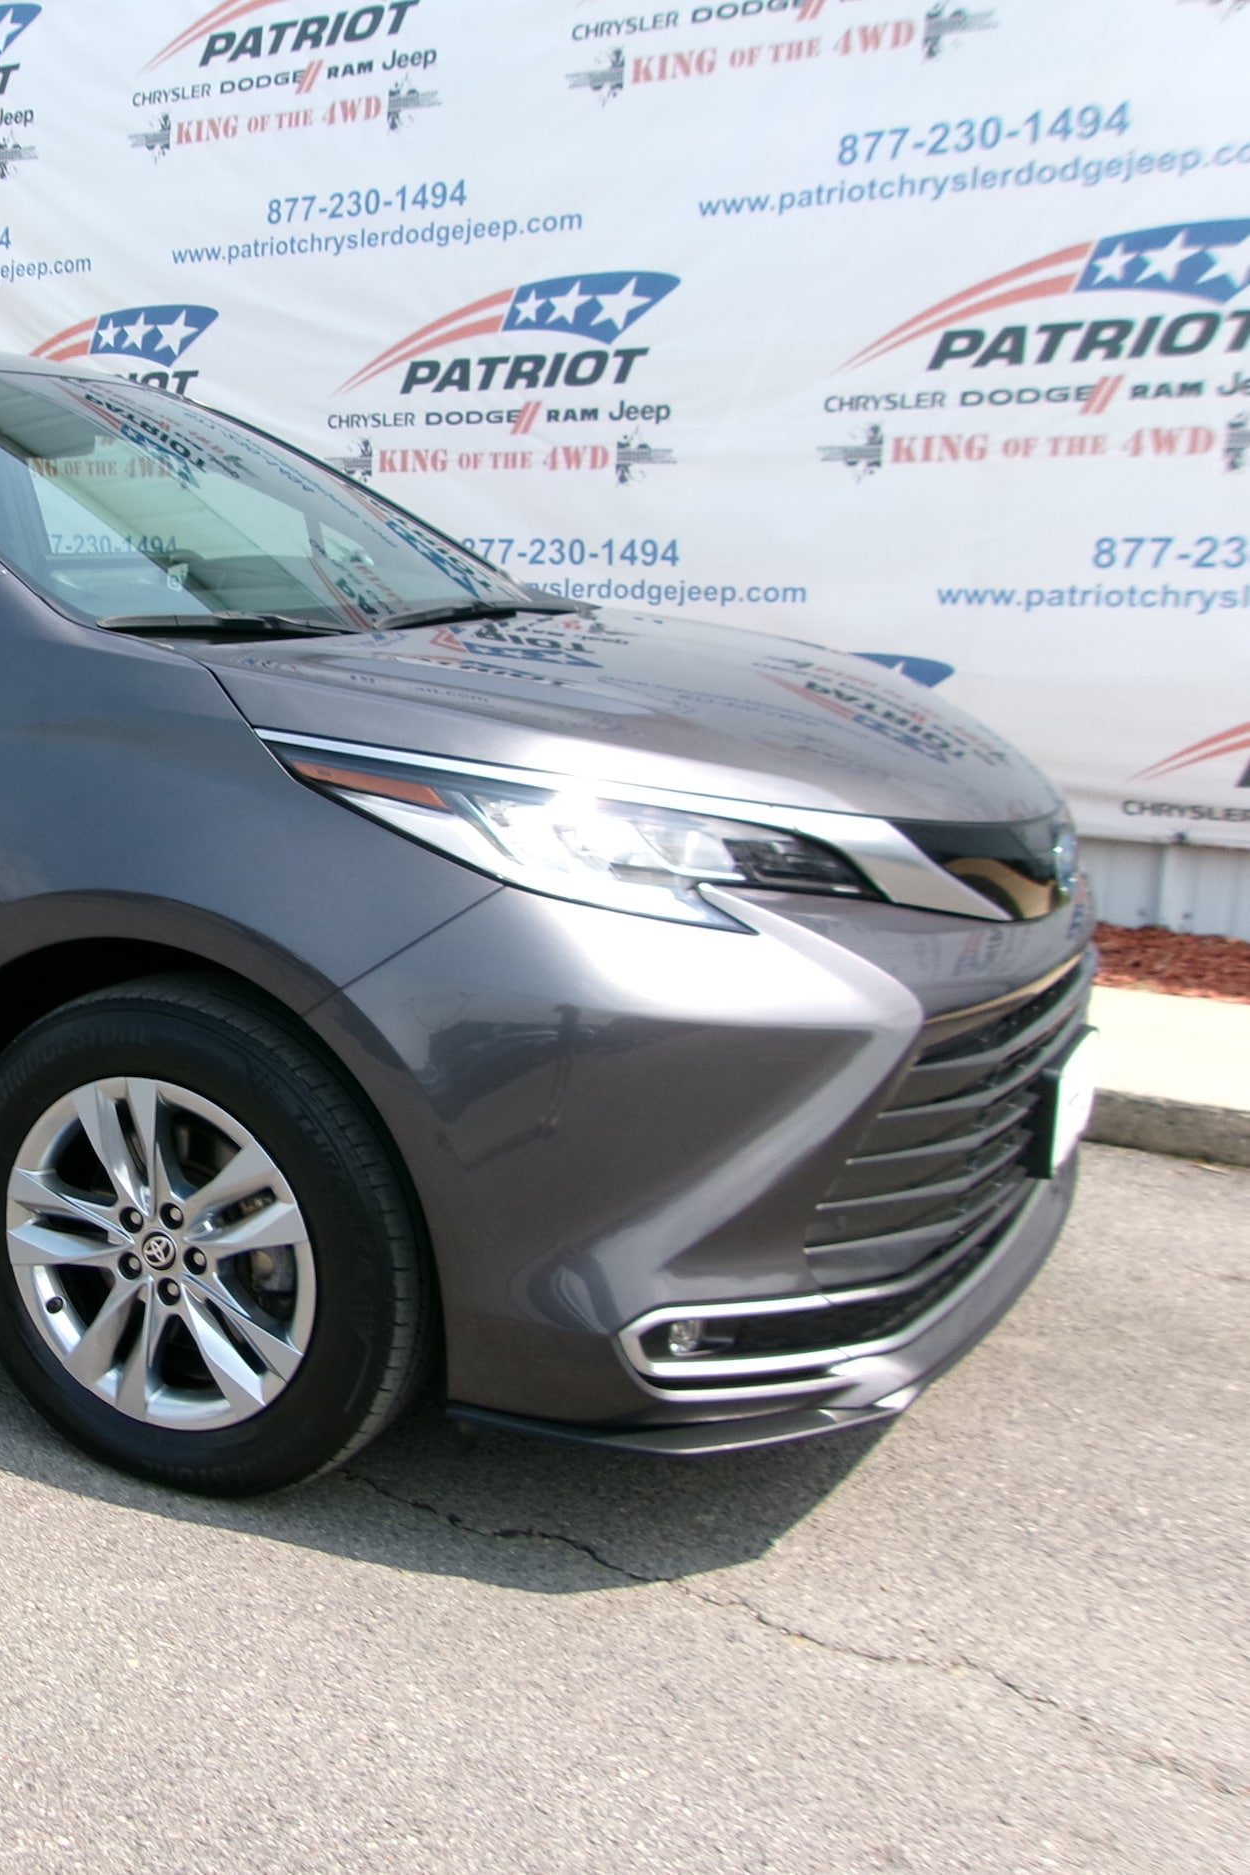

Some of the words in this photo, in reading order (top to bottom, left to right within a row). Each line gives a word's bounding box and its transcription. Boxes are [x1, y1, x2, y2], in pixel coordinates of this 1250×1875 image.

[199, 0, 420, 67] PATRIOT
[570, 11, 680, 42] CHRYSLER
[630, 46, 717, 86] KING
[730, 45, 762, 69] OF
[769, 37, 822, 64] THE
[833, 20, 916, 58] 4WD
[132, 83, 212, 107] CHRYSLER
[220, 69, 304, 94] DODGE
[327, 60, 374, 80] RAM
[382, 47, 437, 72] Jeep
[175, 114, 239, 145] KING
[247, 113, 271, 132] OF
[277, 108, 314, 130] THE
[322, 96, 382, 126] 4WD
[837, 101, 1133, 167] 877-230-1494
[267, 179, 468, 225] 877-230-1494
[171, 211, 583, 265] www.patriotchryslerdodgejeep.com
[400, 347, 650, 394] PATRIOT
[327, 411, 415, 430] CHRYSLER
[425, 409, 522, 426] DODGE
[546, 407, 599, 423] RAM
[609, 400, 671, 426] Jeep
[824, 391, 946, 413] CHRYSLER
[959, 384, 1096, 408] DODGE
[1129, 379, 1204, 400] RAM
[378, 448, 449, 474] KING
[458, 452, 483, 471] OF
[489, 451, 532, 470] THE
[542, 444, 610, 471] 4WD
[890, 433, 989, 465] KING
[1002, 436, 1038, 458] OF
[1048, 433, 1108, 457] THE
[1120, 424, 1216, 457] 4WD
[85, 460, 118, 476] THE
